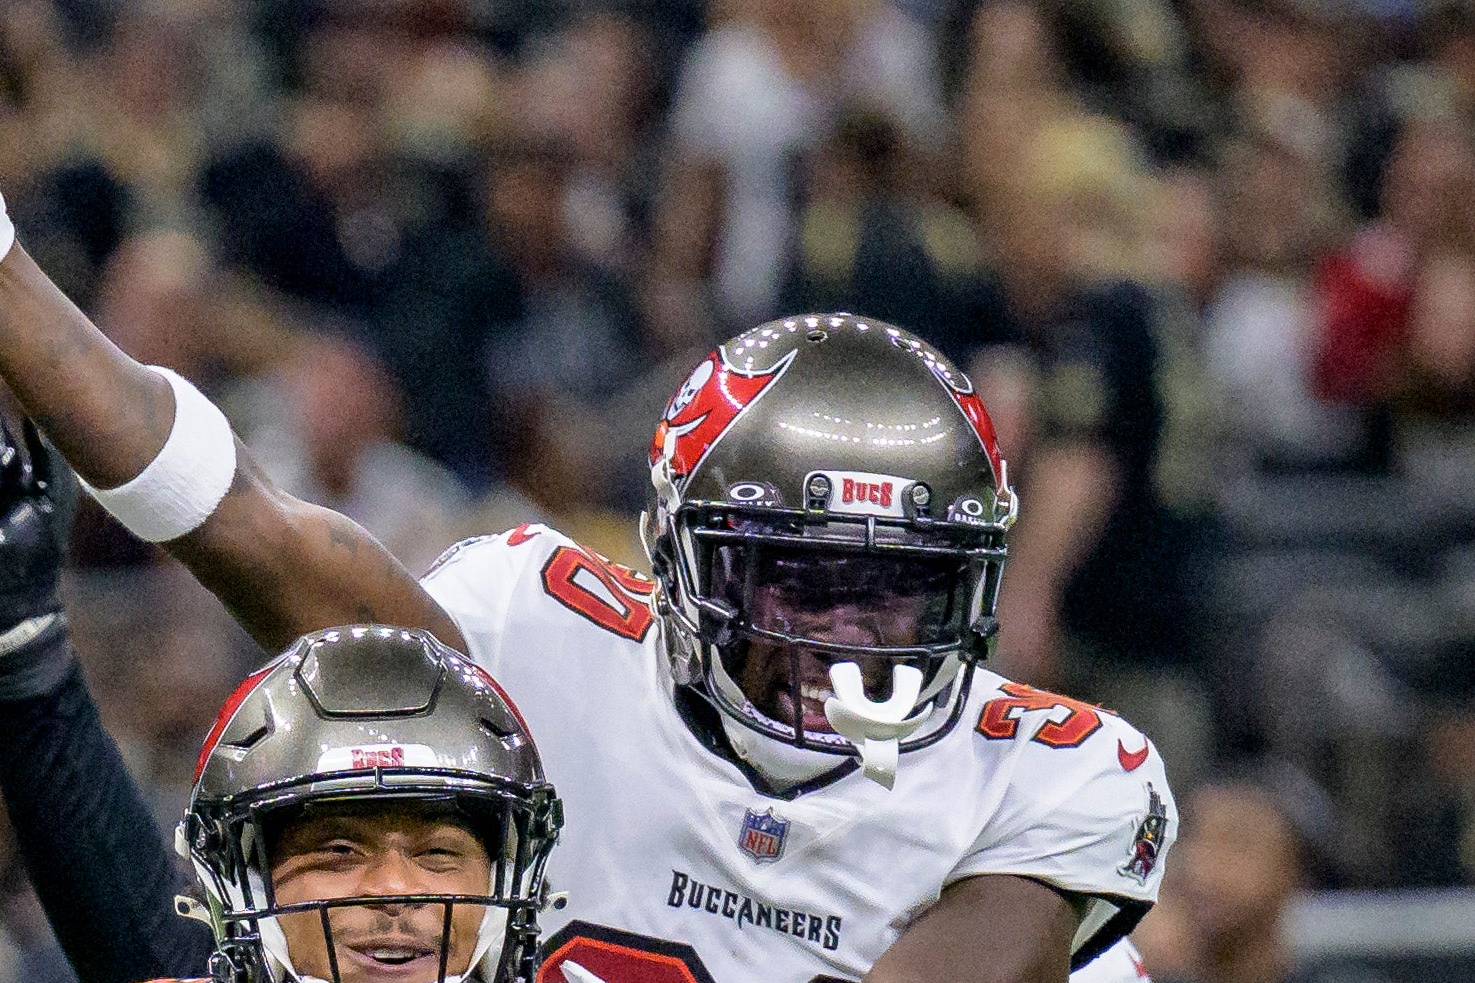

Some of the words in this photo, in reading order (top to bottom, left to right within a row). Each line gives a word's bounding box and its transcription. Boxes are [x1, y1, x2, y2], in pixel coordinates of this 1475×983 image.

[842, 478, 893, 507] BUCS
[745, 829, 777, 855] NFL
[667, 868, 842, 951] BUCCANEERS
